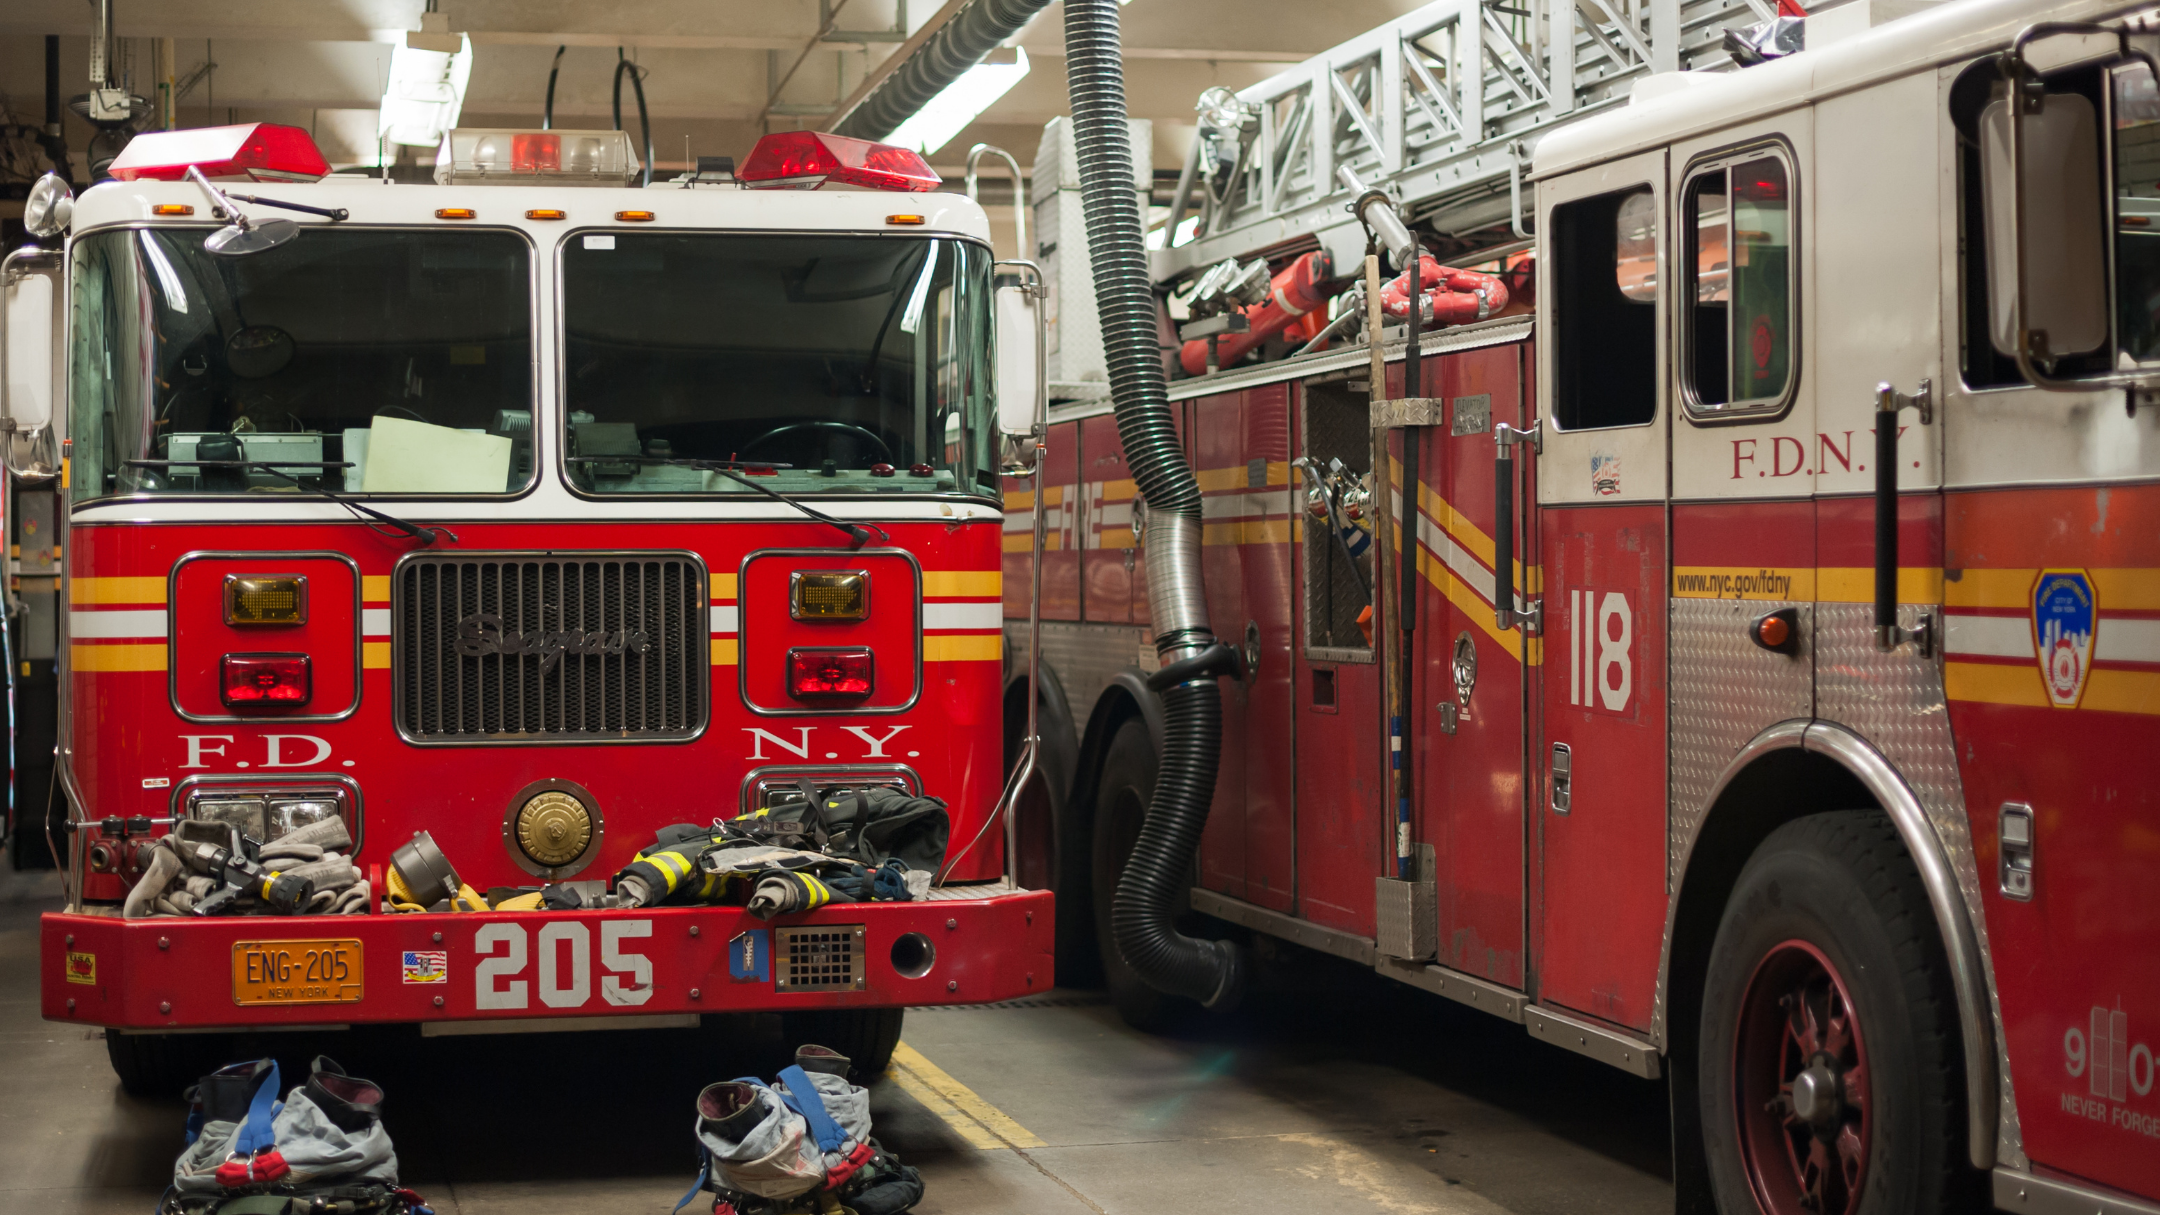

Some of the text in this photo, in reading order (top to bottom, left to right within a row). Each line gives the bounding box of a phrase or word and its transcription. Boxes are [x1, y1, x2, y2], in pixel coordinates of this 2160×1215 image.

[1677, 569, 1791, 600] www.nyc.gov/fdny
[1570, 589, 1632, 712] 118
[178, 734, 356, 769] F.D.
[741, 725, 921, 760] N.Y.
[246, 949, 349, 984] ENG-205
[475, 919, 654, 1010] 205
[268, 985, 329, 999] NEW YORK
[2061, 1092, 2107, 1123] NEVER
